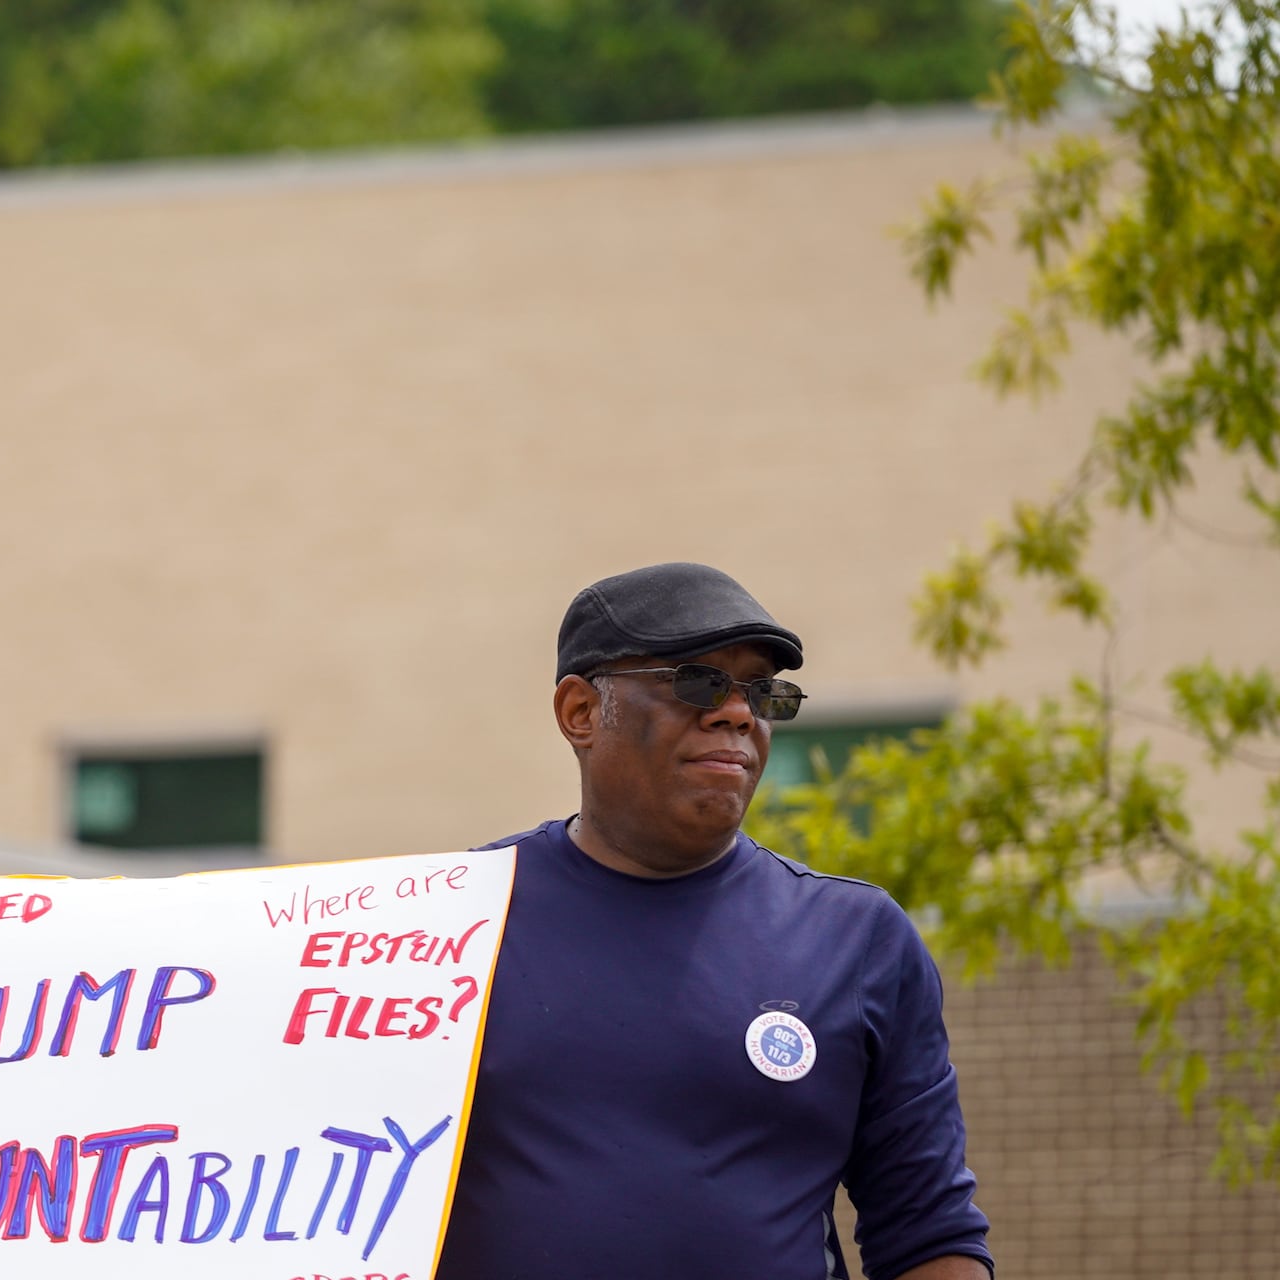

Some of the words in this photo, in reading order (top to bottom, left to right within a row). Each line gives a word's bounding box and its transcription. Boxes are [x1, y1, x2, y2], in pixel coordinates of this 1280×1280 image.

[263, 884, 380, 929] Where
[396, 865, 469, 899] are
[300, 918, 490, 967] EPSTEIN
[282, 975, 479, 1045] FILES?
[759, 1015, 786, 1027] VOTE
[788, 1018, 809, 1040] LIKE
[805, 1041, 813, 1050] A
[773, 1026, 799, 1048] 80%
[750, 1040, 807, 1077] HUNGARIAN
[767, 1044, 792, 1065] 11/3
